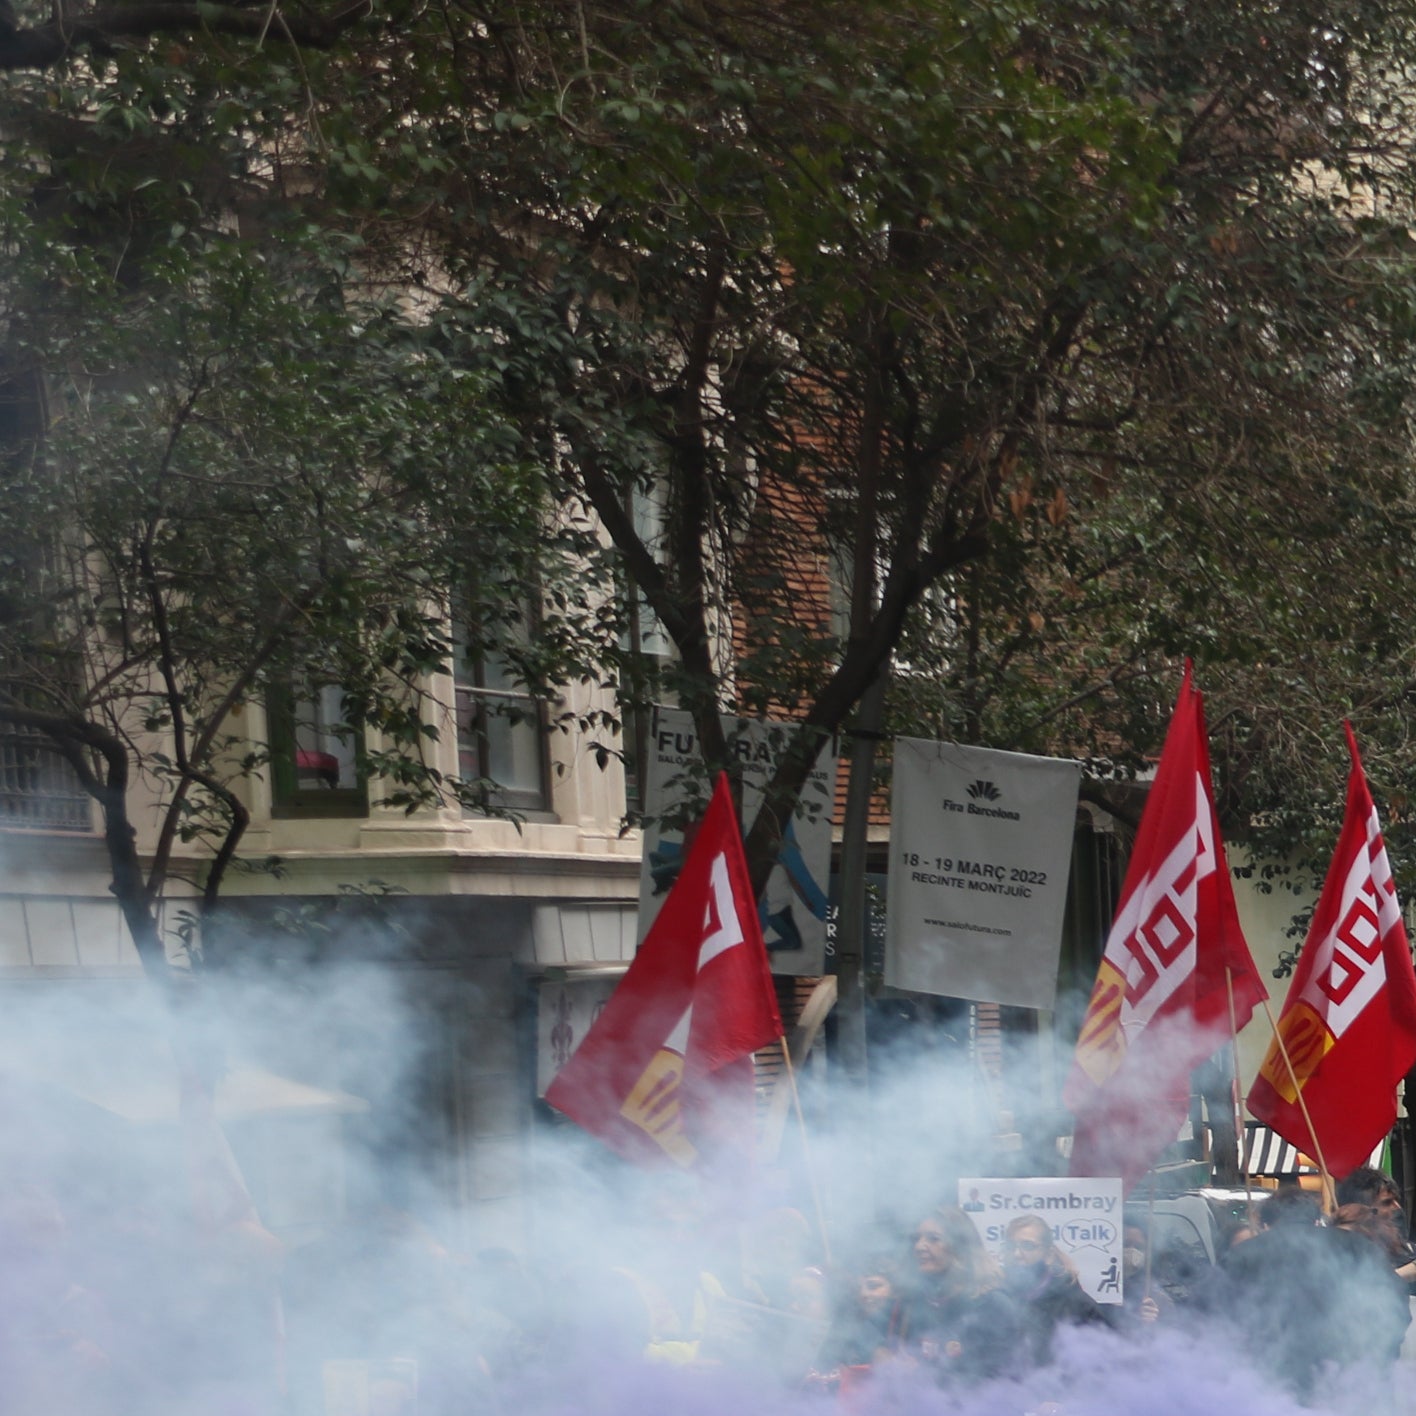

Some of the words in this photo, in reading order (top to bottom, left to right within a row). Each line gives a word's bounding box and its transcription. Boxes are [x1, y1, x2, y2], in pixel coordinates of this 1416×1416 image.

[943, 799, 964, 813] Fira
[967, 803, 1020, 821] Barcelona
[902, 853, 919, 866] 18
[935, 858, 953, 872] 19
[957, 861, 1006, 881] MARÇ
[1010, 868, 1047, 885] 2022
[911, 871, 965, 889] RECINTE
[968, 880, 1033, 898] MONTJUÏC
[1067, 1225, 1111, 1241] Talk
